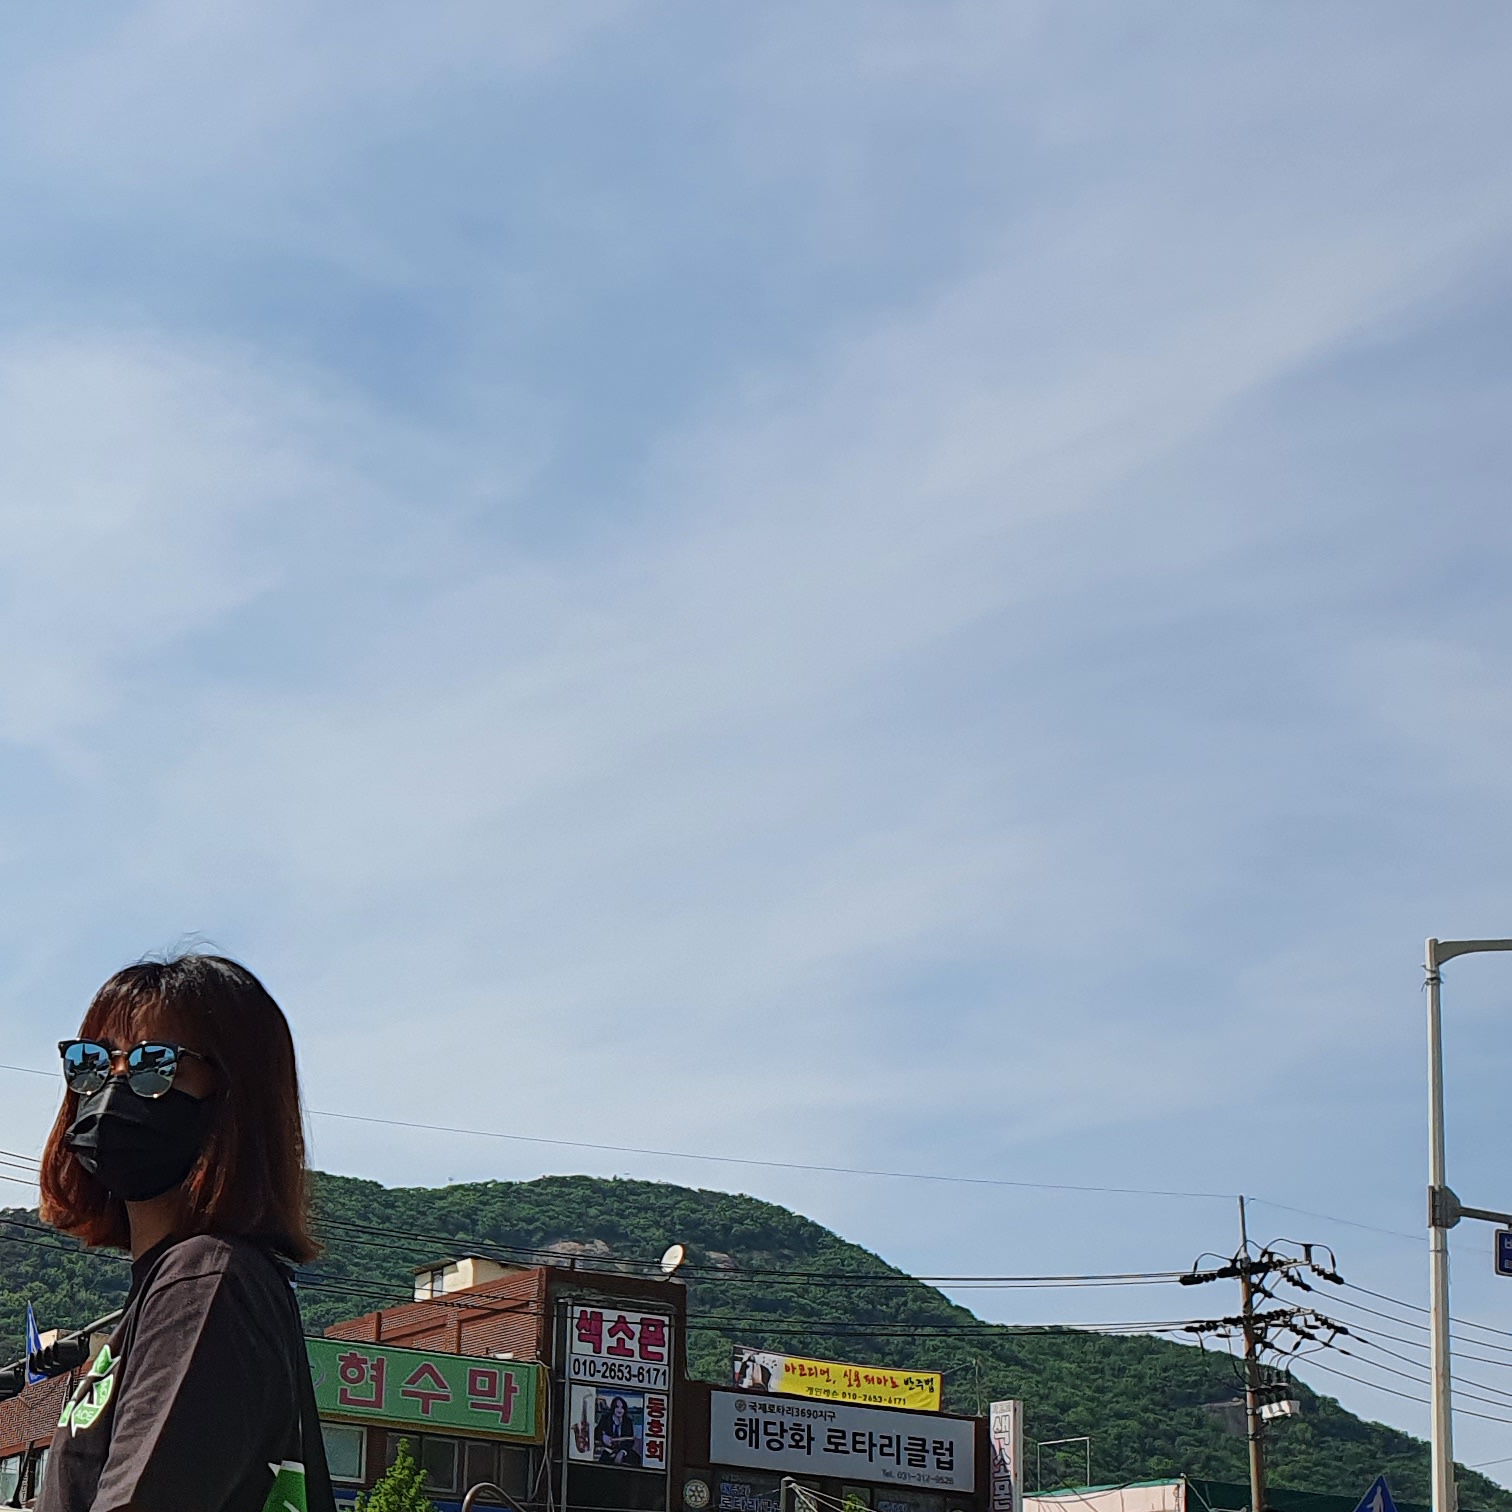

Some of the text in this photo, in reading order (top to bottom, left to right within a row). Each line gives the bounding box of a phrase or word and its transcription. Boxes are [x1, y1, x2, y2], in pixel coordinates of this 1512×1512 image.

[576, 1309, 666, 1362] 색소폰
[338, 1351, 519, 1425] 현수막
[573, 1358, 667, 1386] 010-2653-6171
[645, 1397, 666, 1462] 동호회
[734, 1417, 954, 1471] 해당화 로타리클럽
